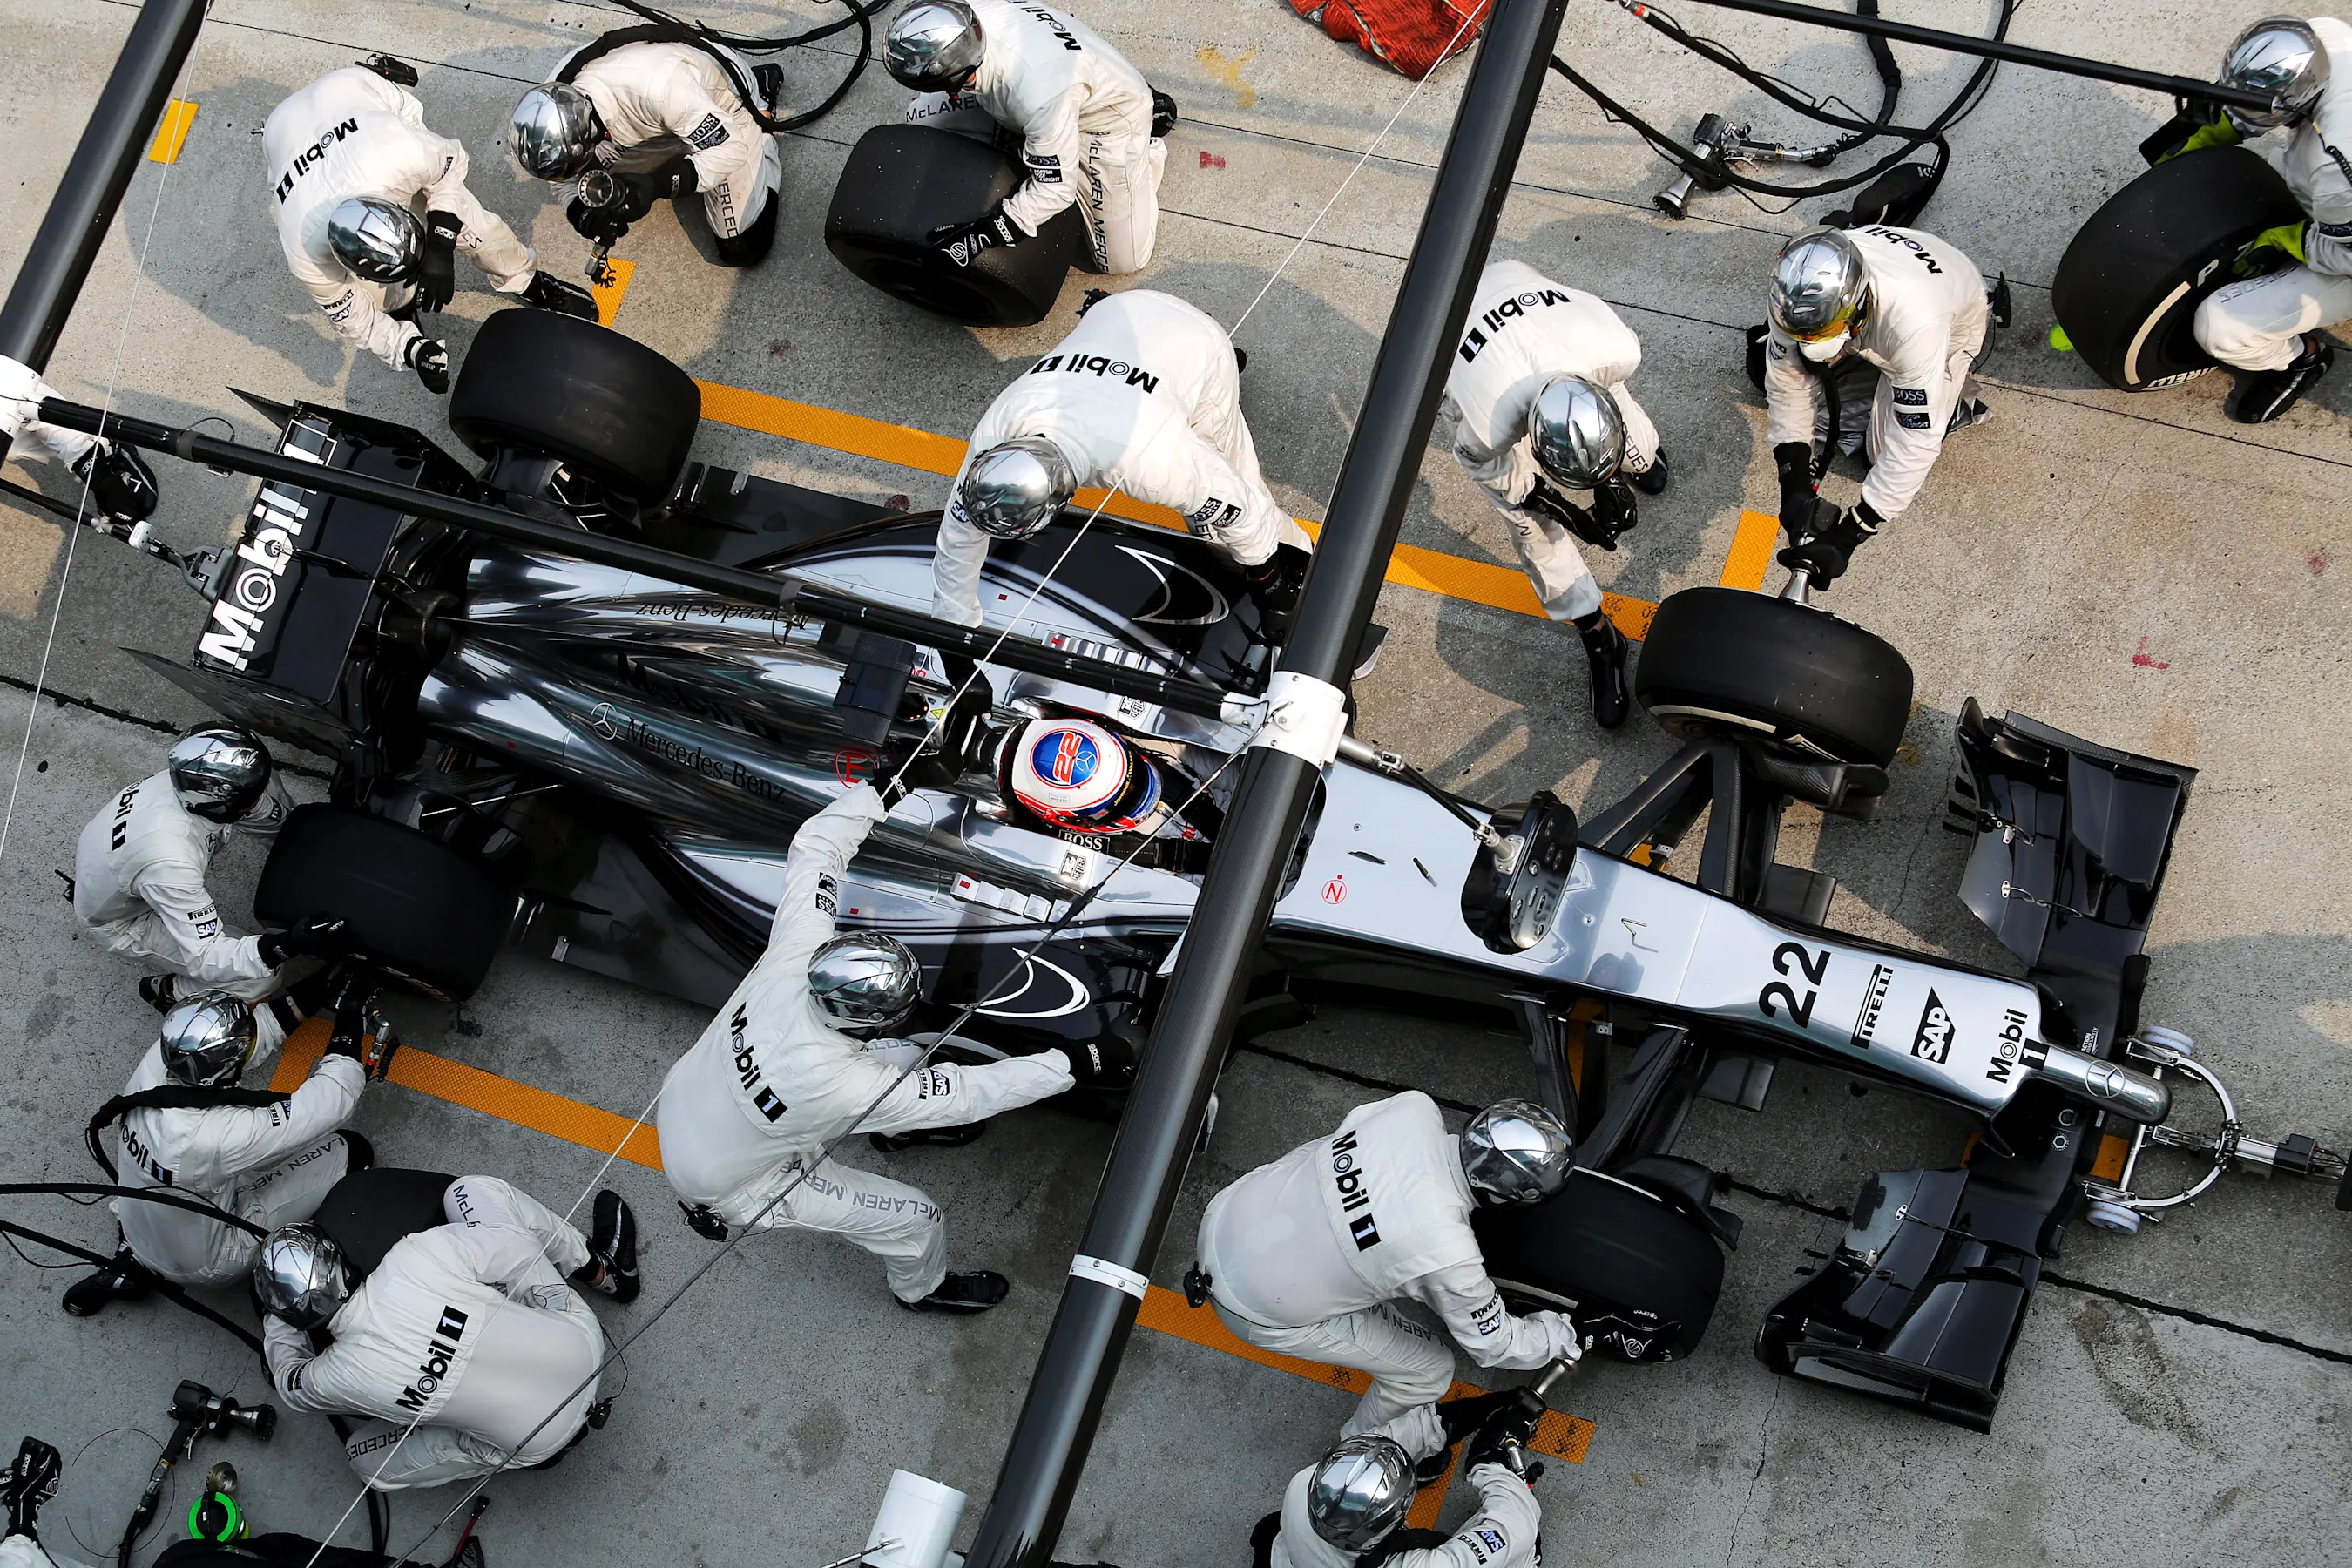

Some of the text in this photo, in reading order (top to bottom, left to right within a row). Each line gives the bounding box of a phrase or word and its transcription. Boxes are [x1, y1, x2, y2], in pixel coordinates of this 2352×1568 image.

[1020, 6, 1082, 51] Mobil
[294, 118, 359, 178] Mobil
[689, 115, 721, 143] BOSS
[718, 179, 740, 238] ERCED
[1864, 227, 1943, 274] Mobil
[2197, 260, 2219, 287] P
[1482, 289, 1571, 333] Mobil
[1066, 354, 1159, 395] Mobil
[1895, 389, 1925, 401] BOSS
[198, 487, 310, 672] Mobil
[626, 717, 787, 804] Mercedes-Benz
[845, 753, 866, 784] E
[1053, 732, 1083, 785] 22
[198, 922, 218, 936] SAP
[1758, 941, 1831, 1029] 22
[1850, 963, 1894, 1050] PIRELLI
[730, 1002, 761, 1091] Mobil
[1917, 1005, 1953, 1063] SAP
[1986, 1008, 2029, 1084] Mobil
[935, 1071, 948, 1096] SAP
[121, 1124, 149, 1169] obil
[288, 1135, 348, 1171] LAREN
[1332, 1129, 1370, 1213] Mobil
[853, 1191, 942, 1223] McLAREN
[1479, 1312, 1502, 1335] SAP
[395, 1339, 456, 1412] Mobil
[1481, 1531, 1504, 1551] SAP
